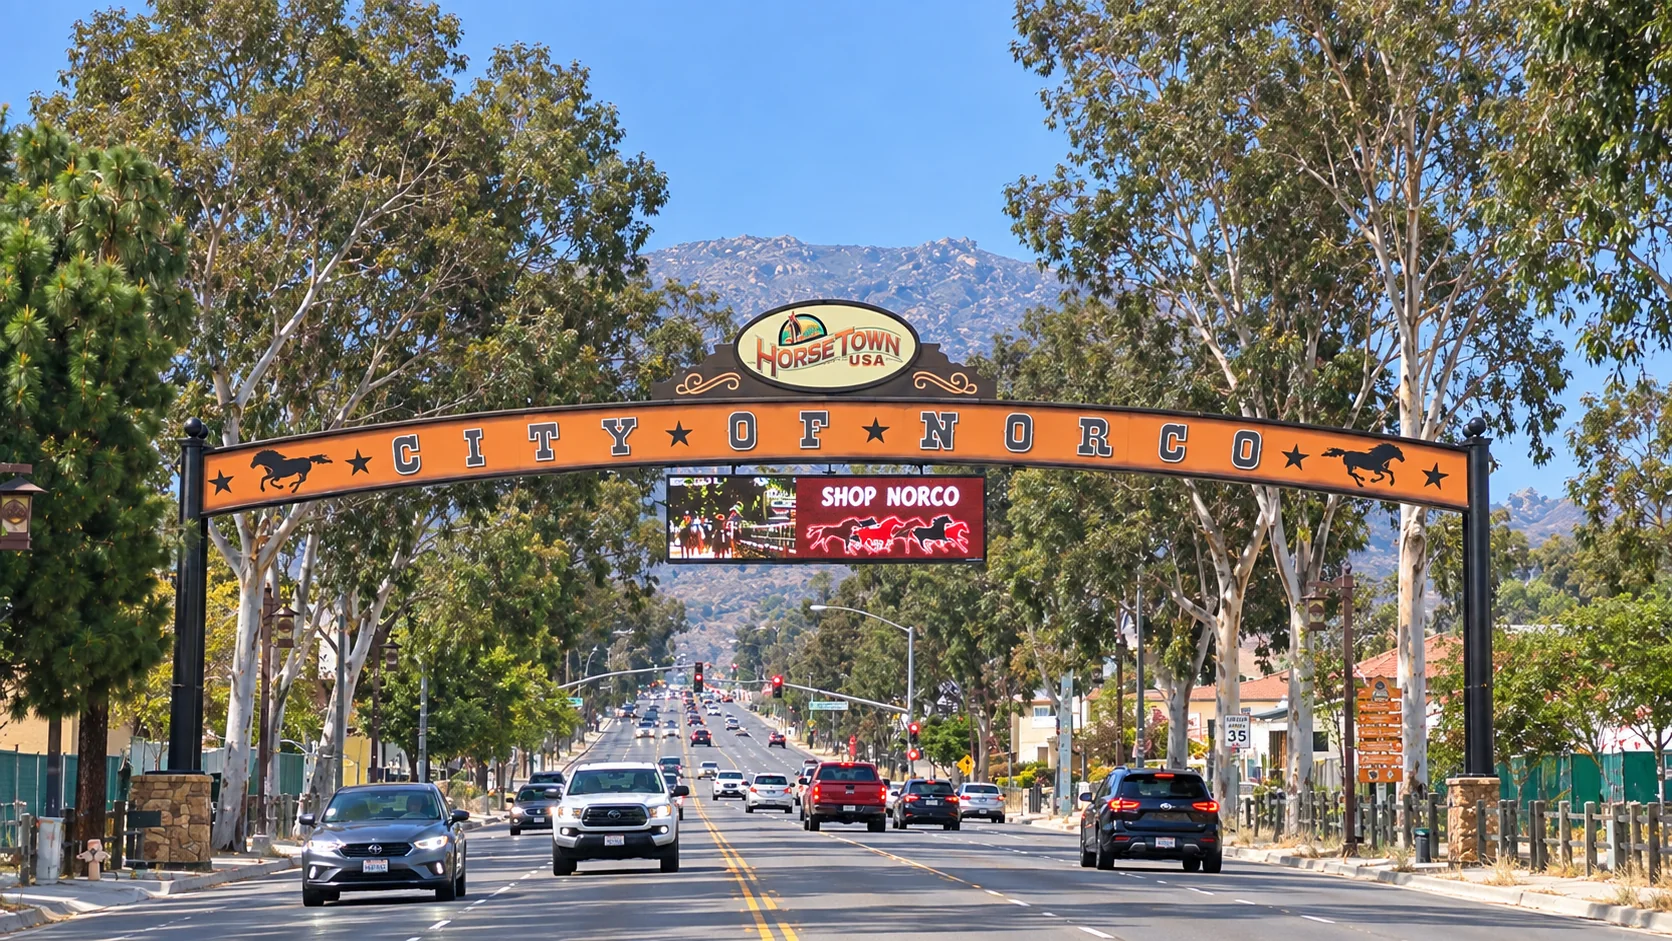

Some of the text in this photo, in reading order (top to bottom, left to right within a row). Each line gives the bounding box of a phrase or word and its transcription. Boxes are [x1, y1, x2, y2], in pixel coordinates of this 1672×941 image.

[849, 354, 885, 367] USA
[391, 410, 1263, 476] CITY OF NORCO
[821, 485, 960, 507] SHOP NORCO
[1227, 730, 1247, 742] 35
